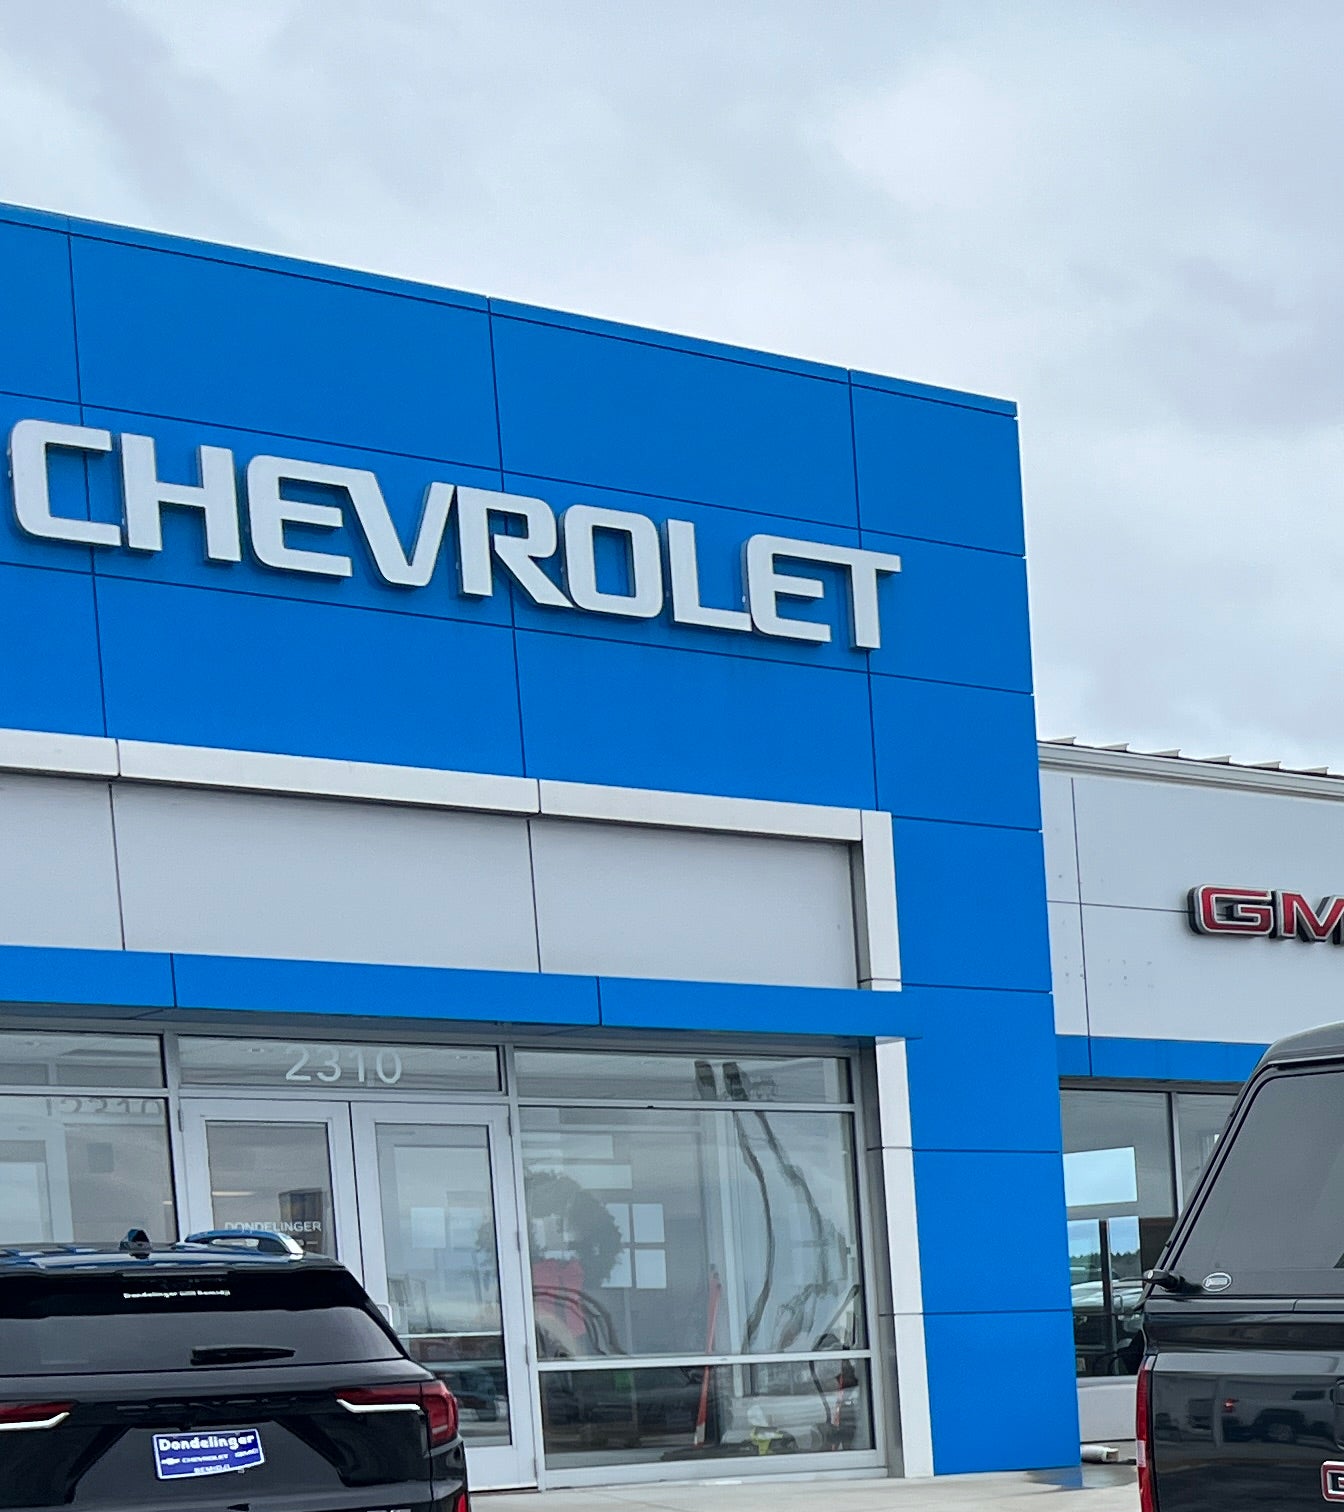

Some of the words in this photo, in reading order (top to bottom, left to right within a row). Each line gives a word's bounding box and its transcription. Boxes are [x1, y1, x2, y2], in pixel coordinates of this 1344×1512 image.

[9, 418, 902, 650] CHEVROLET
[285, 1044, 402, 1084] 2310
[224, 1221, 322, 1234] DONDELINGER
[159, 1435, 255, 1451] Dondelinger
